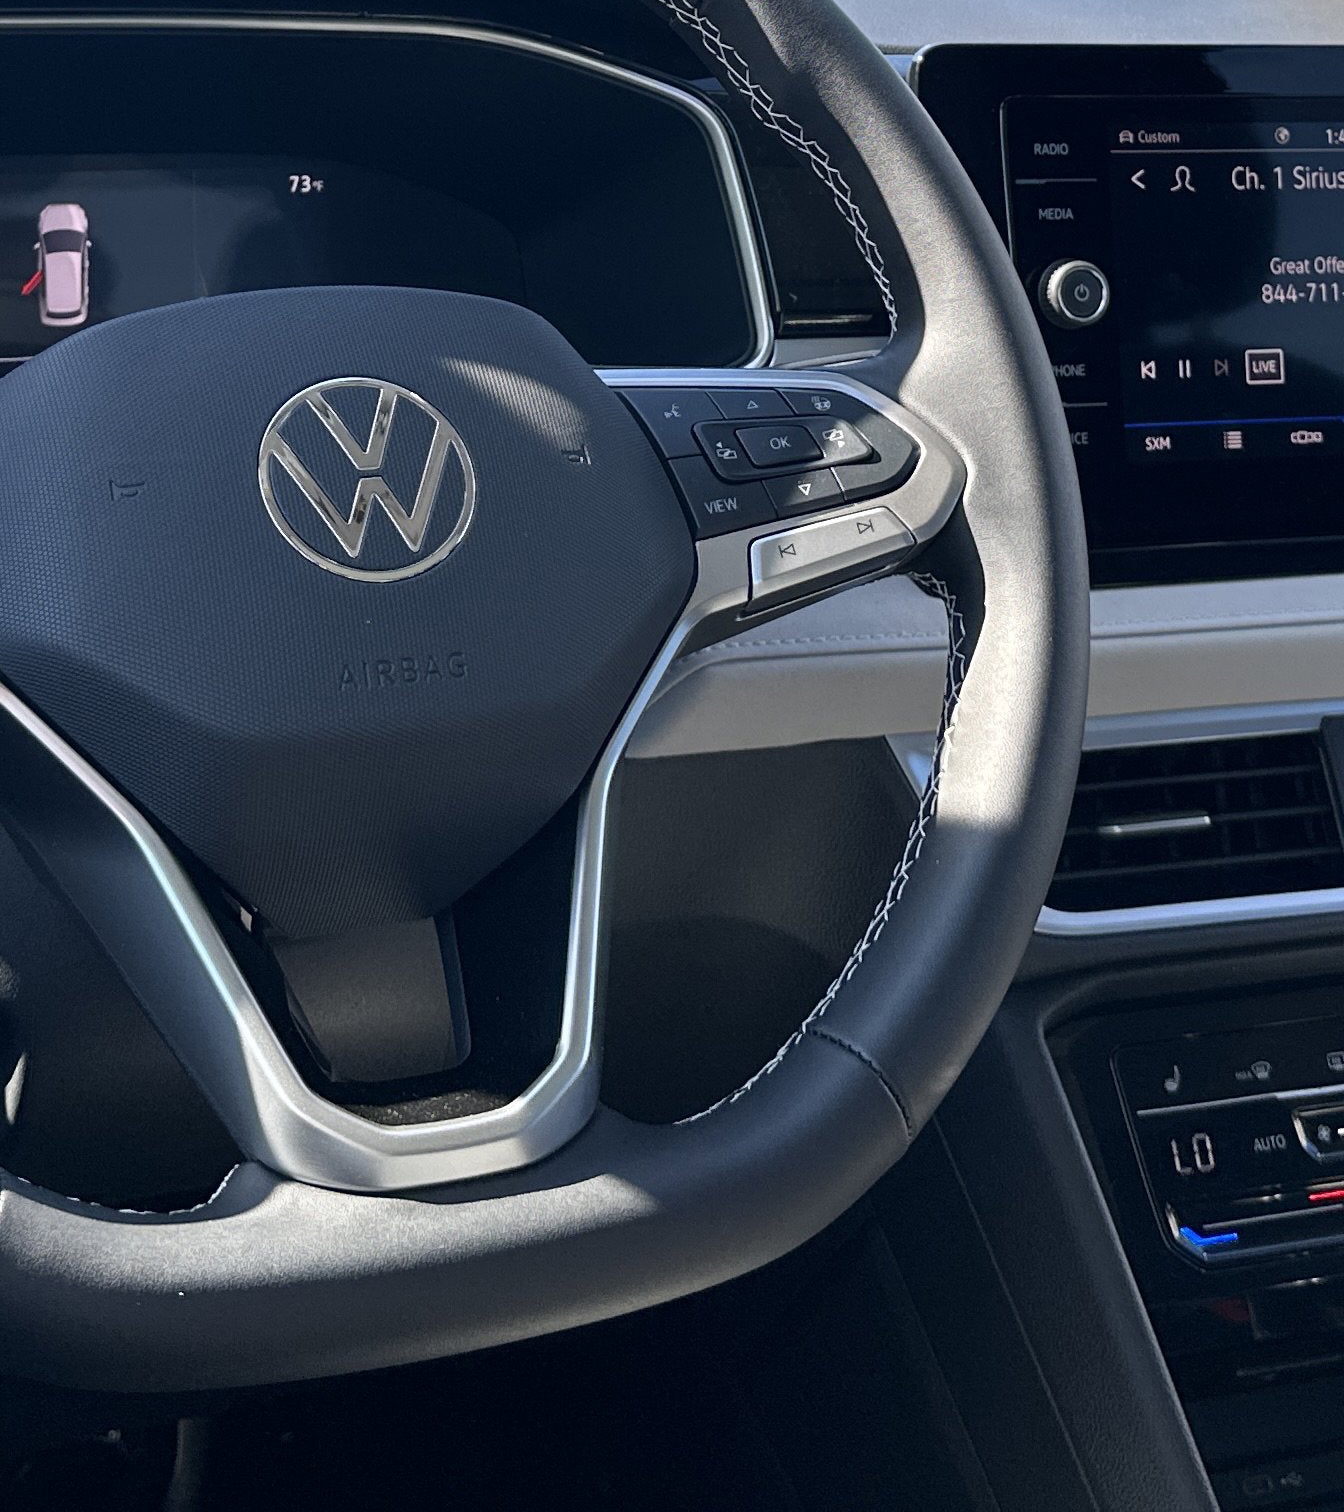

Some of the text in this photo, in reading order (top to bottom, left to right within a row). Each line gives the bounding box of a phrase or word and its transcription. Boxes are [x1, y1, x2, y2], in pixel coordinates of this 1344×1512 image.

[1137, 131, 1181, 144] Custom
[1034, 143, 1070, 156] RADIO
[1231, 165, 1266, 190] Ch.
[1273, 166, 1285, 189] 1
[1038, 207, 1074, 221] MEDIA
[1269, 256, 1311, 275] Great
[1052, 363, 1087, 377] HONE
[1252, 360, 1277, 374] LIVE
[768, 436, 792, 451] OK
[1070, 431, 1089, 445] ICE
[1145, 436, 1172, 451] SXM
[703, 497, 738, 515] VIEW
[340, 651, 469, 690] AIRBAG
[1253, 1134, 1288, 1152] AUTO
[1170, 1131, 1216, 1176] LO
